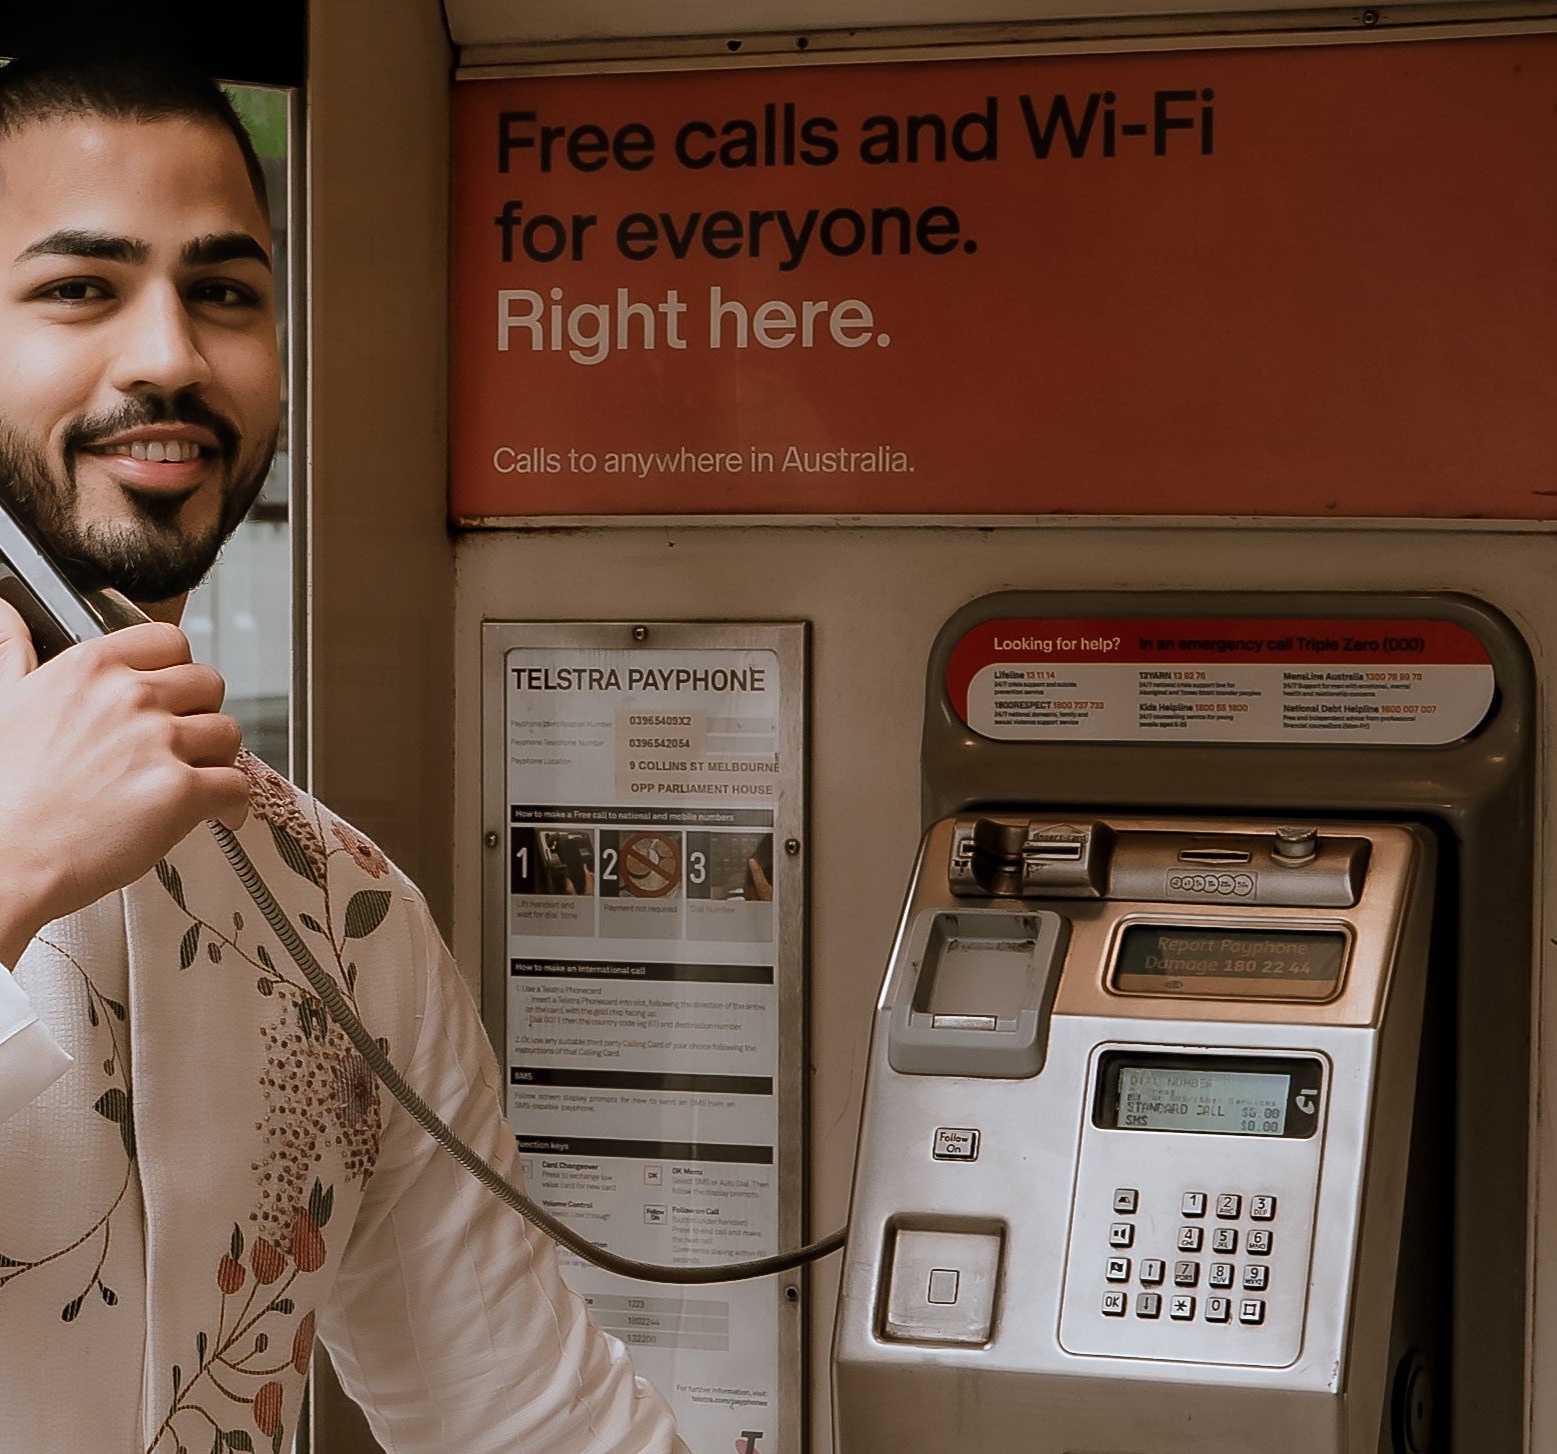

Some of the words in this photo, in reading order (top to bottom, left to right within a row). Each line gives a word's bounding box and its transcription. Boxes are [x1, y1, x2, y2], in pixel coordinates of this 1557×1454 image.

[496, 110, 654, 172] Free
[675, 103, 838, 169] calls
[860, 96, 997, 163] and
[1019, 89, 1214, 159] Wi-Fi
[495, 200, 596, 263] for
[616, 203, 977, 272] everyone.
[497, 288, 688, 364] Right
[711, 287, 891, 350] here.
[493, 446, 561, 474] Calls
[567, 450, 597, 474] to
[604, 446, 742, 479] anywhere
[750, 446, 773, 473] in
[781, 446, 915, 473] Australia.
[994, 637, 1052, 653] Looking
[1056, 637, 1077, 650] for
[1081, 637, 1121, 653] help?
[1157, 640, 1176, 650] an
[1178, 640, 1262, 653] emergency
[1267, 638, 1292, 650] call
[1296, 638, 1338, 652] Triple
[1343, 638, 1379, 650] Zero
[1384, 637, 1425, 653] (000)
[511, 669, 622, 691] TELSTRA
[629, 669, 766, 692] PAYPHONE
[1159, 703, 1193, 712] Helpline
[1283, 705, 1319, 713] National
[1322, 705, 1342, 713] Debt
[1344, 705, 1379, 714] Helpline
[629, 761, 636, 770] 9
[638, 761, 687, 771] COLLINS
[690, 761, 704, 771] ST
[631, 783, 655, 794] OPP
[658, 783, 729, 795] PARLIAMENT
[732, 785, 773, 795] HOUSE
[516, 847, 528, 879] 1
[602, 848, 618, 881] 2
[690, 851, 706, 884] 3
[1157, 937, 1215, 955] Report
[1221, 939, 1308, 958] Payphone
[1145, 956, 1218, 975] Damage
[1224, 959, 1258, 973] 180
[1262, 961, 1284, 974] 22
[1289, 962, 1312, 975] 44
[1125, 1114, 1148, 1126] SMS
[939, 1131, 969, 1143] Follow
[946, 1143, 962, 1153] On
[1189, 1194, 1196, 1206] 1
[1223, 1197, 1232, 1208] 2
[1257, 1198, 1266, 1209] 3
[1185, 1229, 1192, 1240] 4
[1219, 1230, 1228, 1242] 5
[1254, 1232, 1263, 1243] 6
[1181, 1263, 1189, 1274] 7
[1216, 1265, 1224, 1277] 8
[1250, 1267, 1259, 1279] 9
[1105, 1295, 1120, 1308] OK
